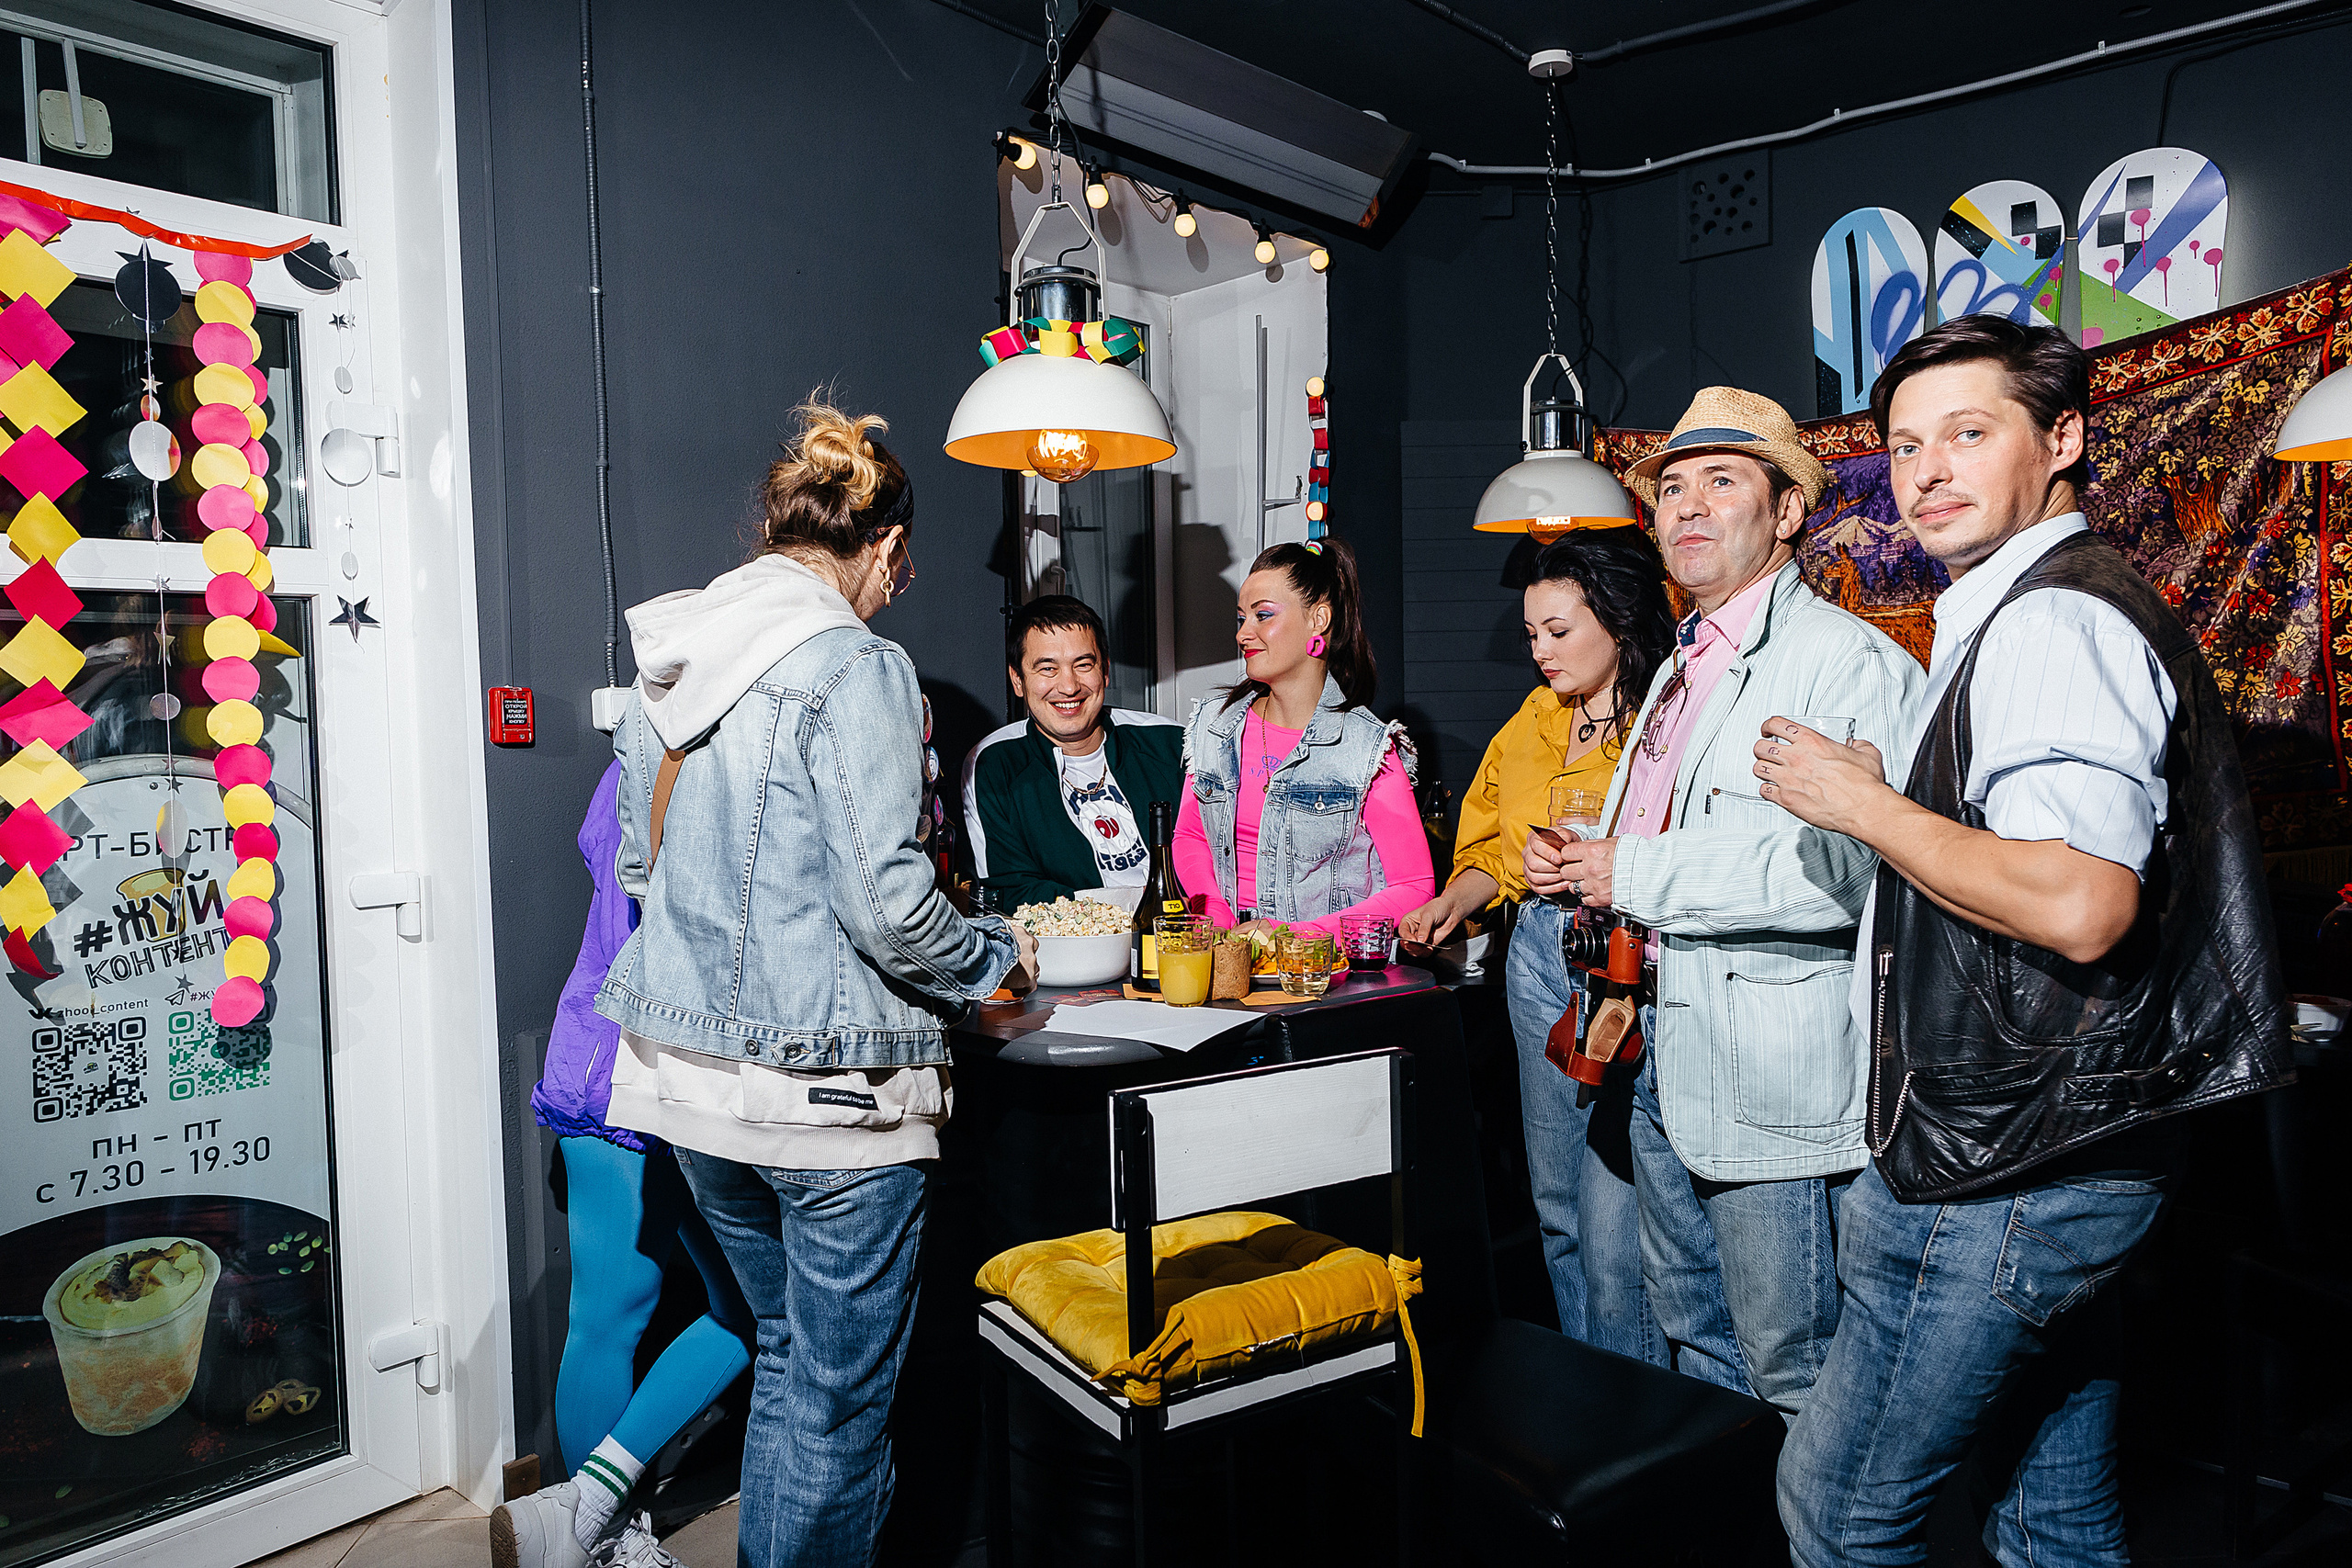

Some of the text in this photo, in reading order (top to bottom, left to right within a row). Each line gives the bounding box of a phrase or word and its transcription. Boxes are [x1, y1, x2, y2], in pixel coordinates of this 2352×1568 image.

[85, 926, 232, 989] КОНТЕНТ
[70, 1160, 144, 1198] 7.30
[189, 1136, 270, 1175] 19.30
